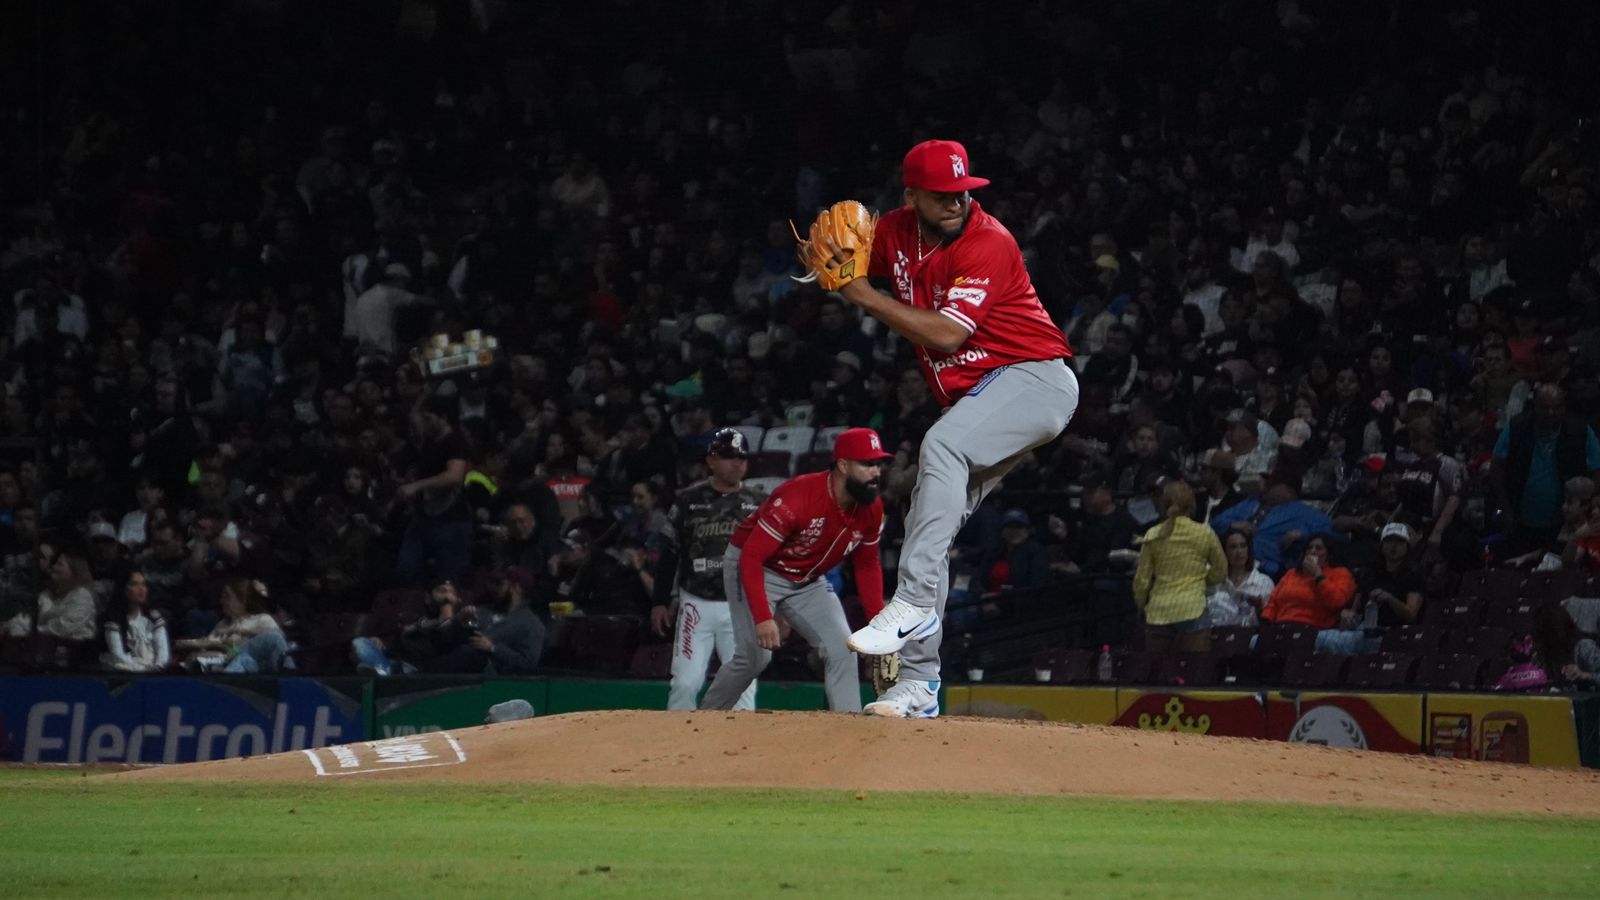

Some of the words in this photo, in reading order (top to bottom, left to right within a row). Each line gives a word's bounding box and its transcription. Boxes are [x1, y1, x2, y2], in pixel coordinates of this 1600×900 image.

[935, 347, 988, 372] petroil
[681, 602, 702, 660] Caliente
[23, 701, 342, 763] Electrolit
